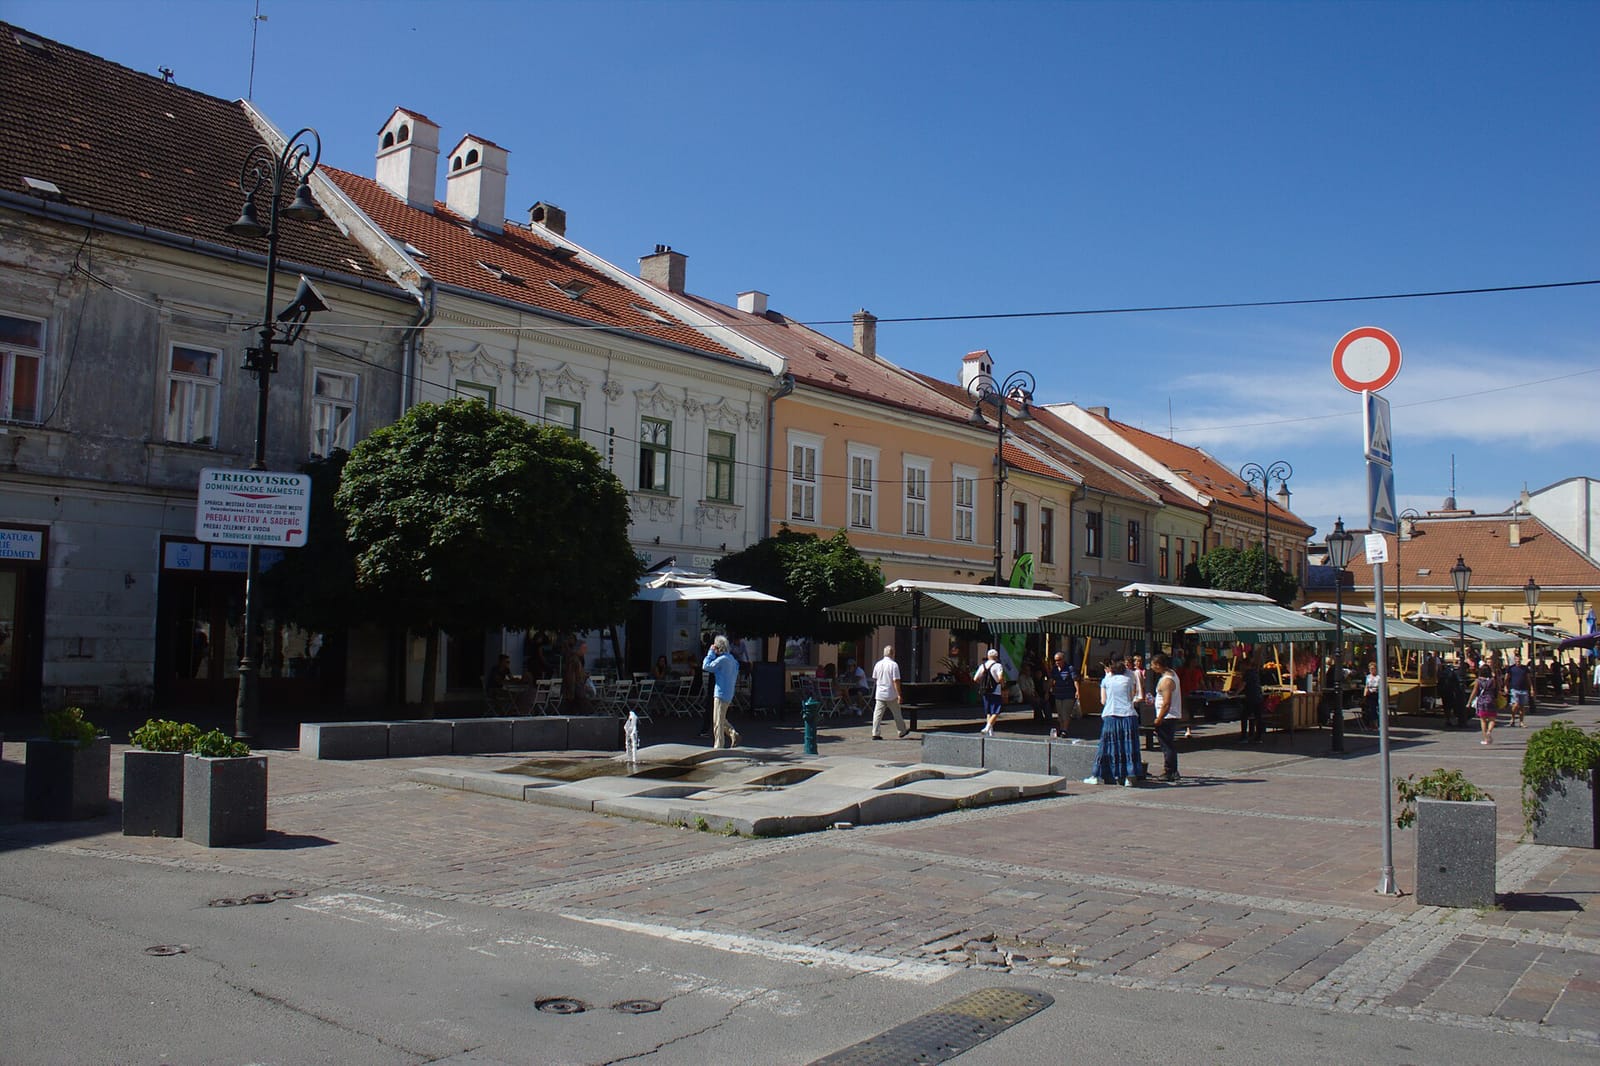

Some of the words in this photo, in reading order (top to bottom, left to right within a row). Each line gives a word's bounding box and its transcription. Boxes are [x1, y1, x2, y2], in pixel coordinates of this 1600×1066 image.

[211, 472, 300, 486] TRHOVISKO
[205, 482, 264, 493] DOMINIKÁNSKE
[266, 486, 304, 496] NÁMESTIE
[205, 513, 231, 522] PREDAJ
[234, 514, 259, 523] KVETOV
